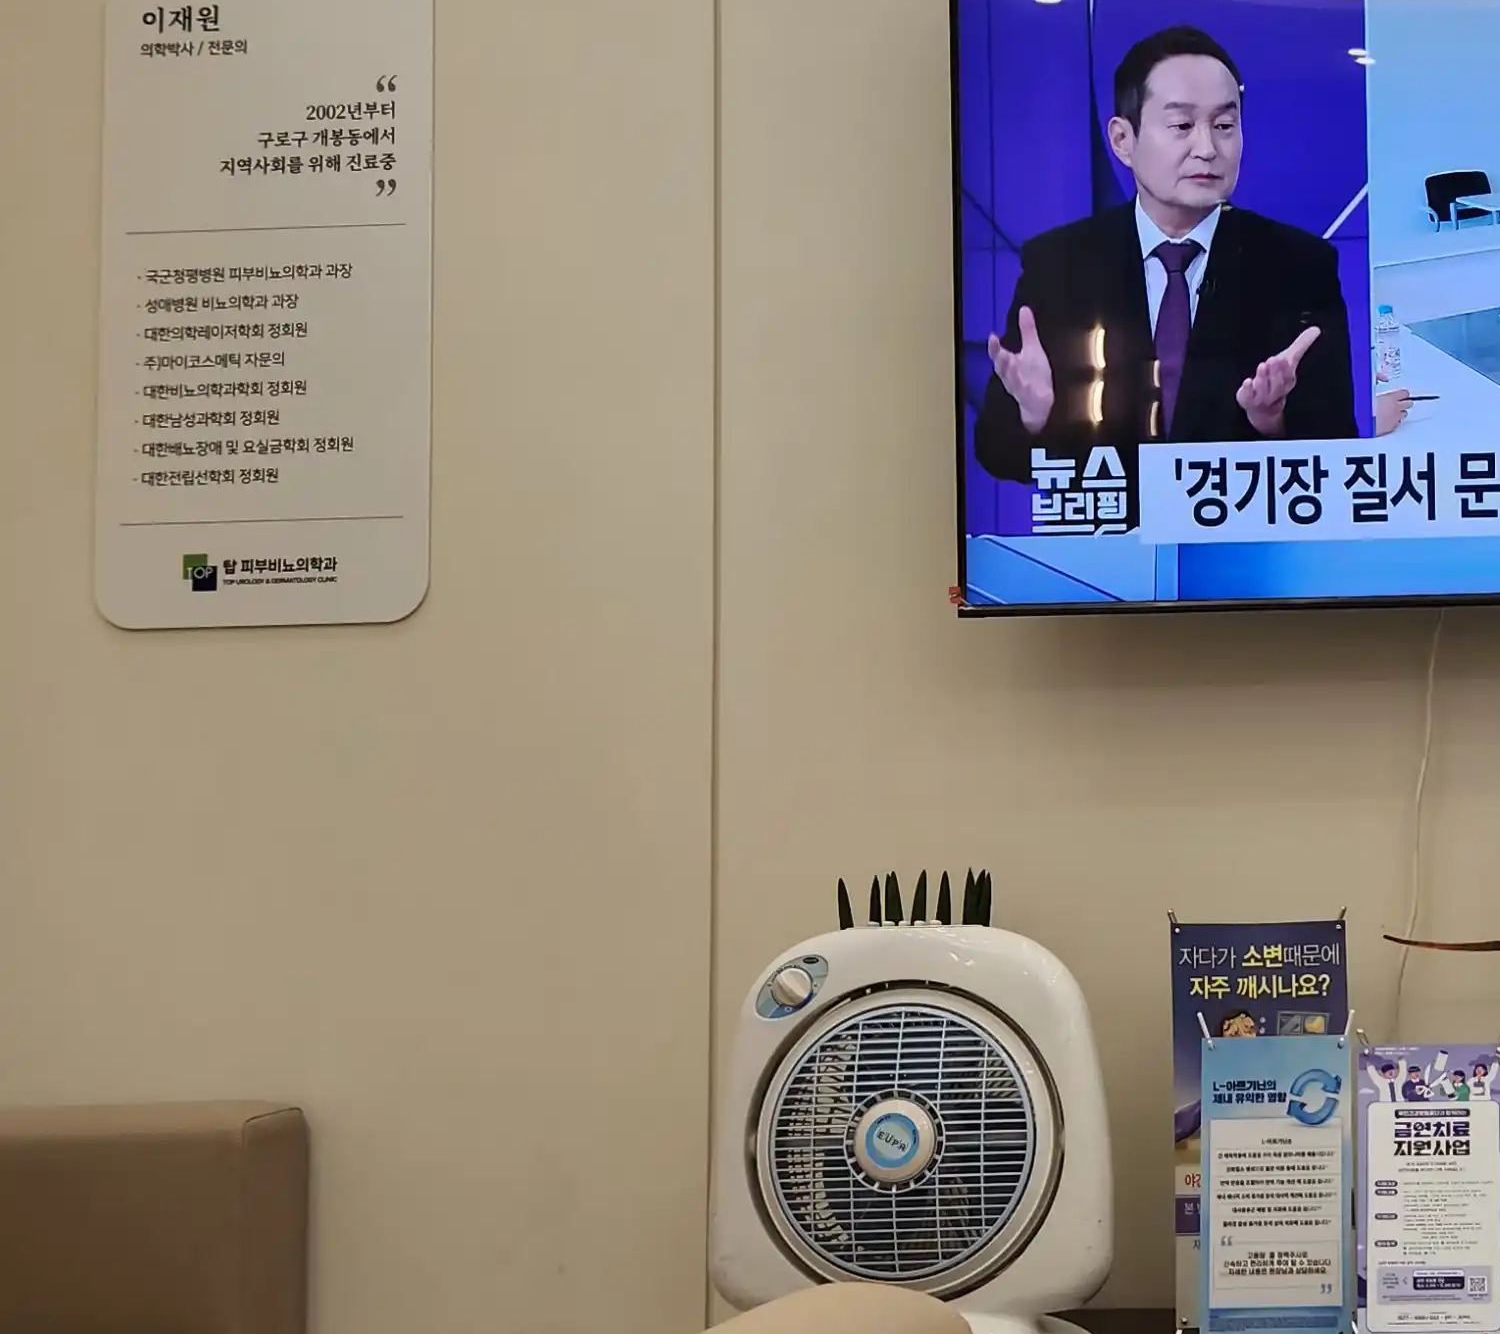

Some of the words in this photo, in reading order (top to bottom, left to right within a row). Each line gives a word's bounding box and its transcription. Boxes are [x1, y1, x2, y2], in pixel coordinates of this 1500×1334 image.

[142, 5, 220, 33] 이재원
[140, 41, 194, 57] 의학박사
[208, 39, 248, 56] 전문의
[306, 101, 396, 121] 2002년부터
[257, 131, 309, 149] 구로구
[312, 127, 396, 147] 개봉동에서
[220, 155, 304, 176] 지역사회를
[308, 154, 341, 173] 위해
[346, 153, 396, 172] 진료중
[229, 264, 323, 281] 피부비뇨의학과
[325, 263, 353, 279] 과장
[202, 295, 268, 311] 비뇨의학과
[272, 293, 299, 309] 과장
[144, 323, 265, 342] 대한의학레이저학회
[268, 321, 308, 339] 정회원
[244, 351, 285, 367] 자문의
[267, 379, 307, 397] 정회원
[142, 411, 236, 429] 대한남성과학회
[240, 410, 280, 427] 정회원
[226, 440, 239, 455] 및
[243, 439, 310, 454] 요실금학회
[313, 436, 354, 453] 정회원
[141, 469, 235, 486] 대한전립선학회
[239, 468, 279, 485] 정회원
[1031, 445, 1127, 490] 뉴스
[1174, 456, 1328, 527] '경기장
[1343, 452, 1438, 522] 질서
[1032, 491, 1127, 522] 브리핑
[187, 566, 214, 580] TOP
[223, 559, 237, 575] 탑
[240, 556, 338, 574] 피부비뇨의학과
[1178, 945, 1237, 969] 자다가
[1241, 943, 1341, 968] 소변때문에
[1189, 975, 1231, 1000] 자주
[1236, 973, 1331, 999] 깨시나요?
[1394, 1121, 1471, 1139] 금연치료
[876, 1130, 908, 1153] EUPA
[1394, 1139, 1471, 1156] 지원사업
